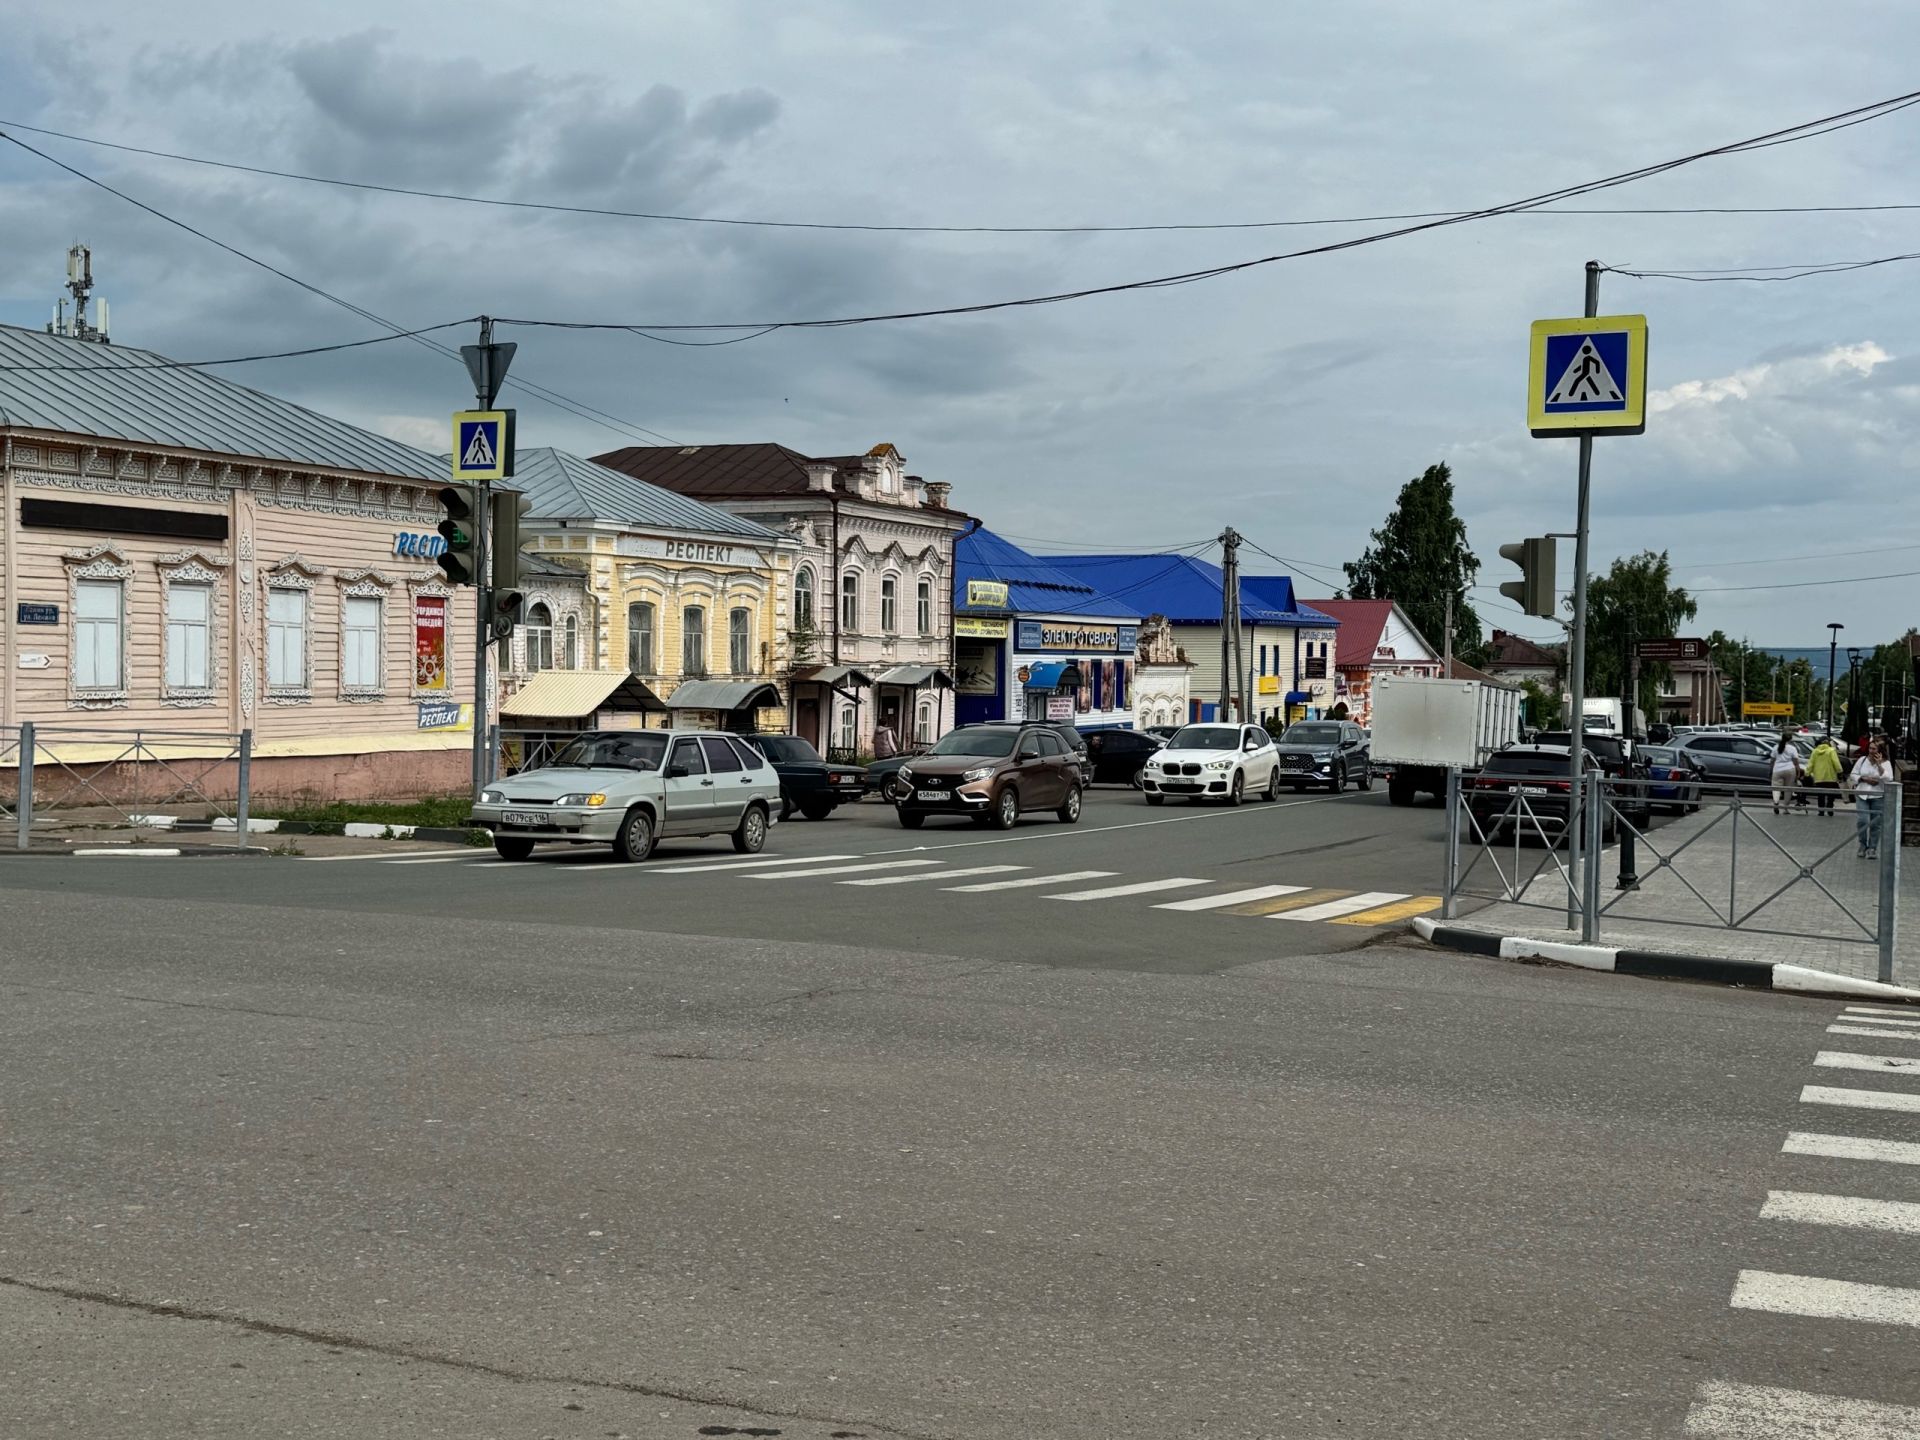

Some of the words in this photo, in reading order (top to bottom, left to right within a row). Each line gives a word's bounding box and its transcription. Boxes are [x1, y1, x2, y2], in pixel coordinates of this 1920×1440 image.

[666, 541, 733, 563] РЕСПЕКТ
[1043, 629, 1117, 646] ЭЛЕКТРОТОВАРЫ
[420, 710, 458, 727] РЕСПЕКТ
